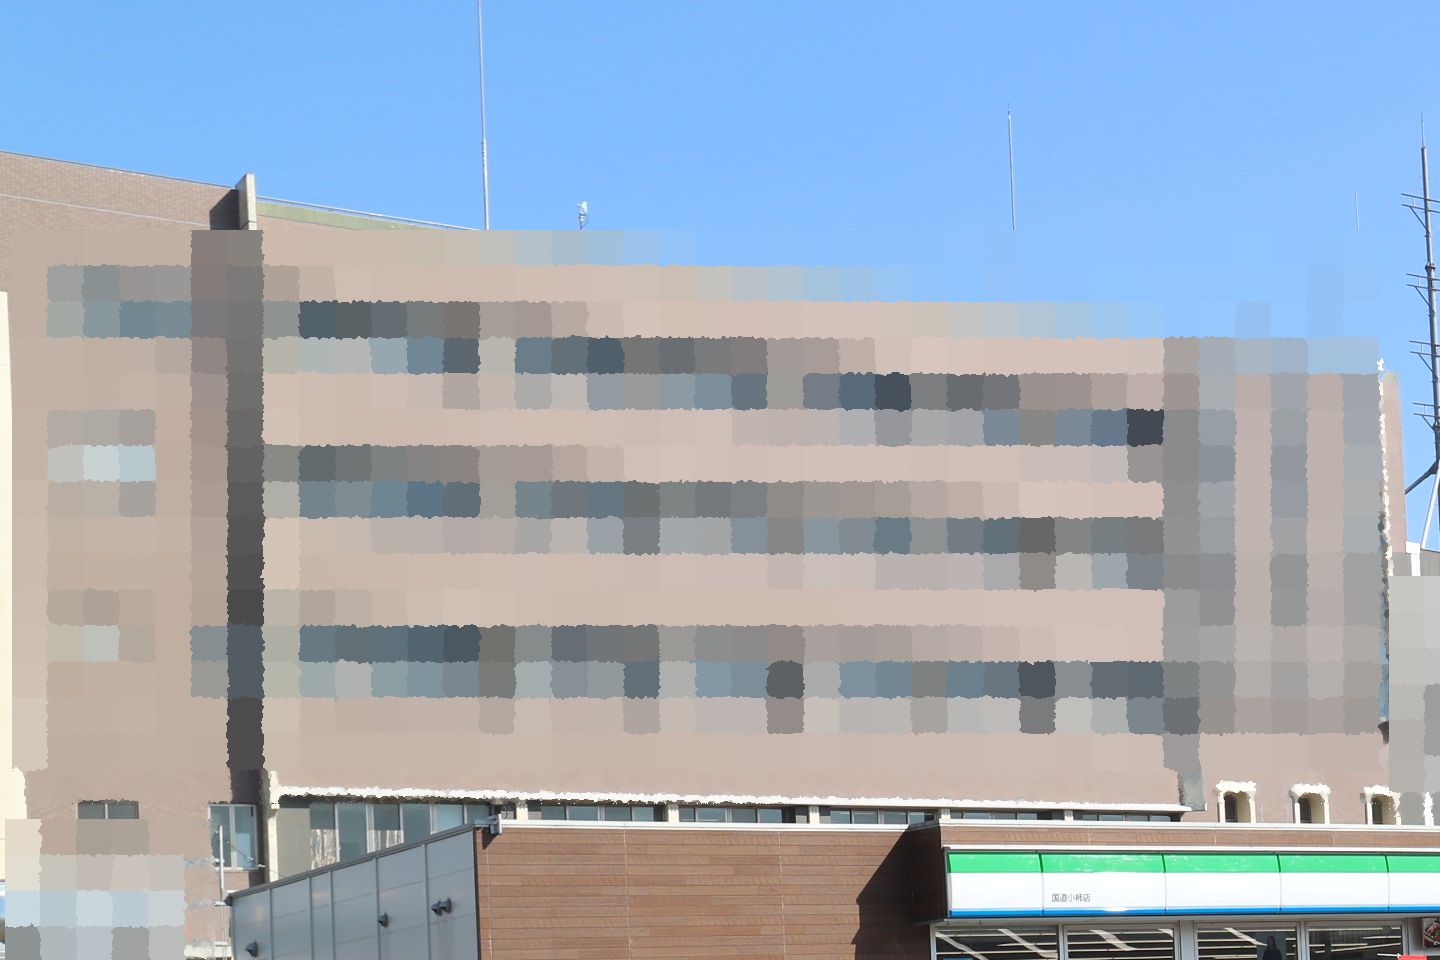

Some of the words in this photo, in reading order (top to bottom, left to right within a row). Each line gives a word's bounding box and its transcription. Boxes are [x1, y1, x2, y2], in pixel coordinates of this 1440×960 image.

[1051, 893, 1091, 903] 国道小柿店
